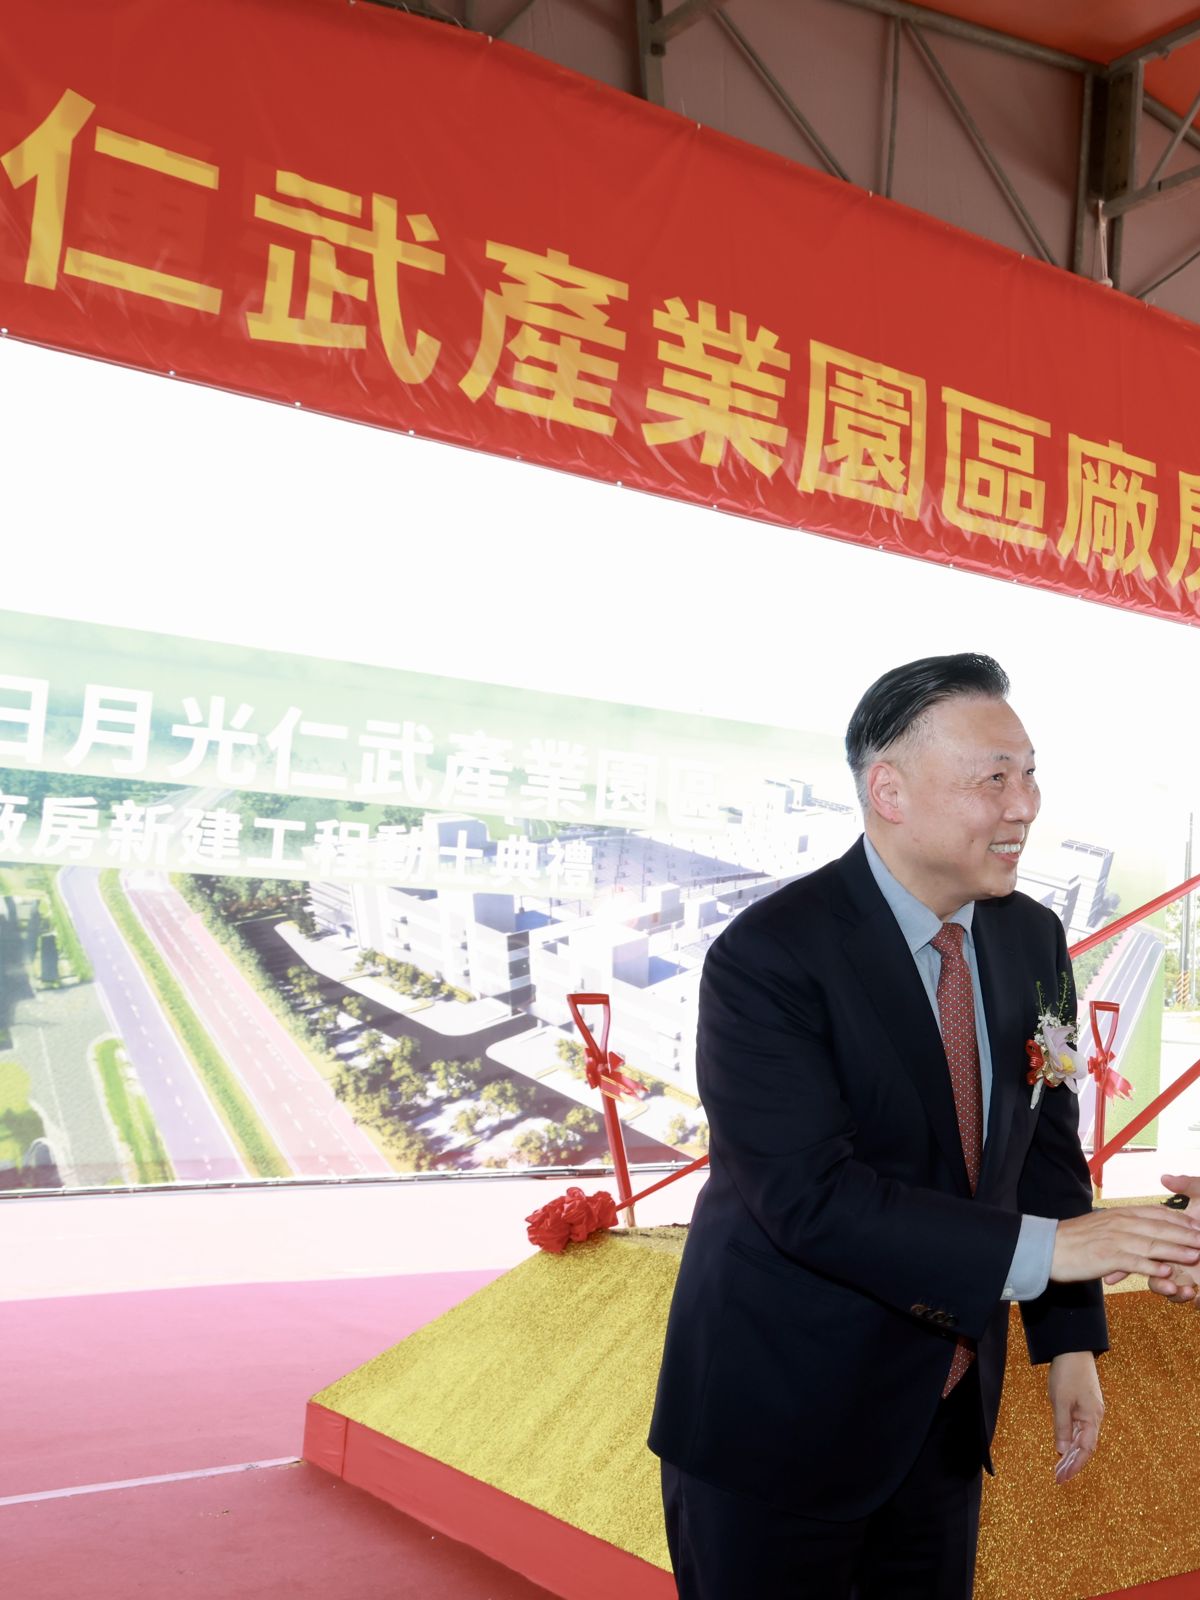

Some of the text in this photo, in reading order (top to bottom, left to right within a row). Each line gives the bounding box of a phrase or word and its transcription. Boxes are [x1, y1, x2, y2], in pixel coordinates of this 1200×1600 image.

[0, 674, 725, 830] 日月光仁武產業園區
